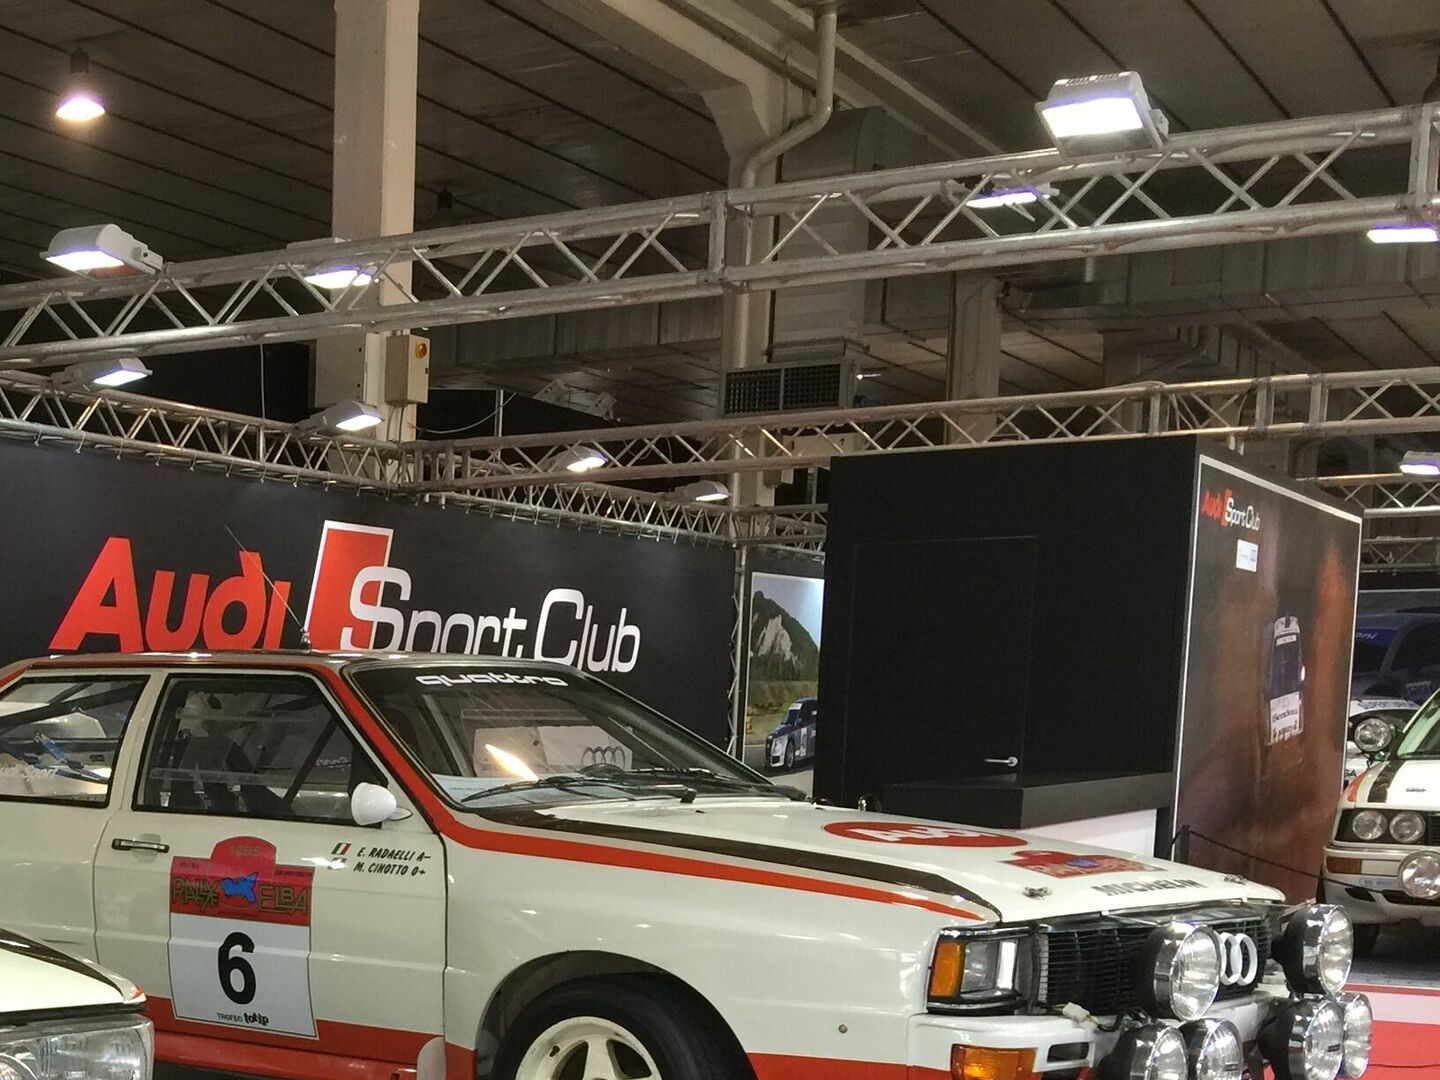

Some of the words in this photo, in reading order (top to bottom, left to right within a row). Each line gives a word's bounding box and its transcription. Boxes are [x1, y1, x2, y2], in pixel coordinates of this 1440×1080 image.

[48, 536, 292, 651] Audi
[533, 588, 641, 673] Club
[415, 671, 568, 687] quattro
[368, 847, 415, 861] RADAELLI
[368, 862, 409, 876] CINOTTO
[218, 931, 257, 1005] 6
